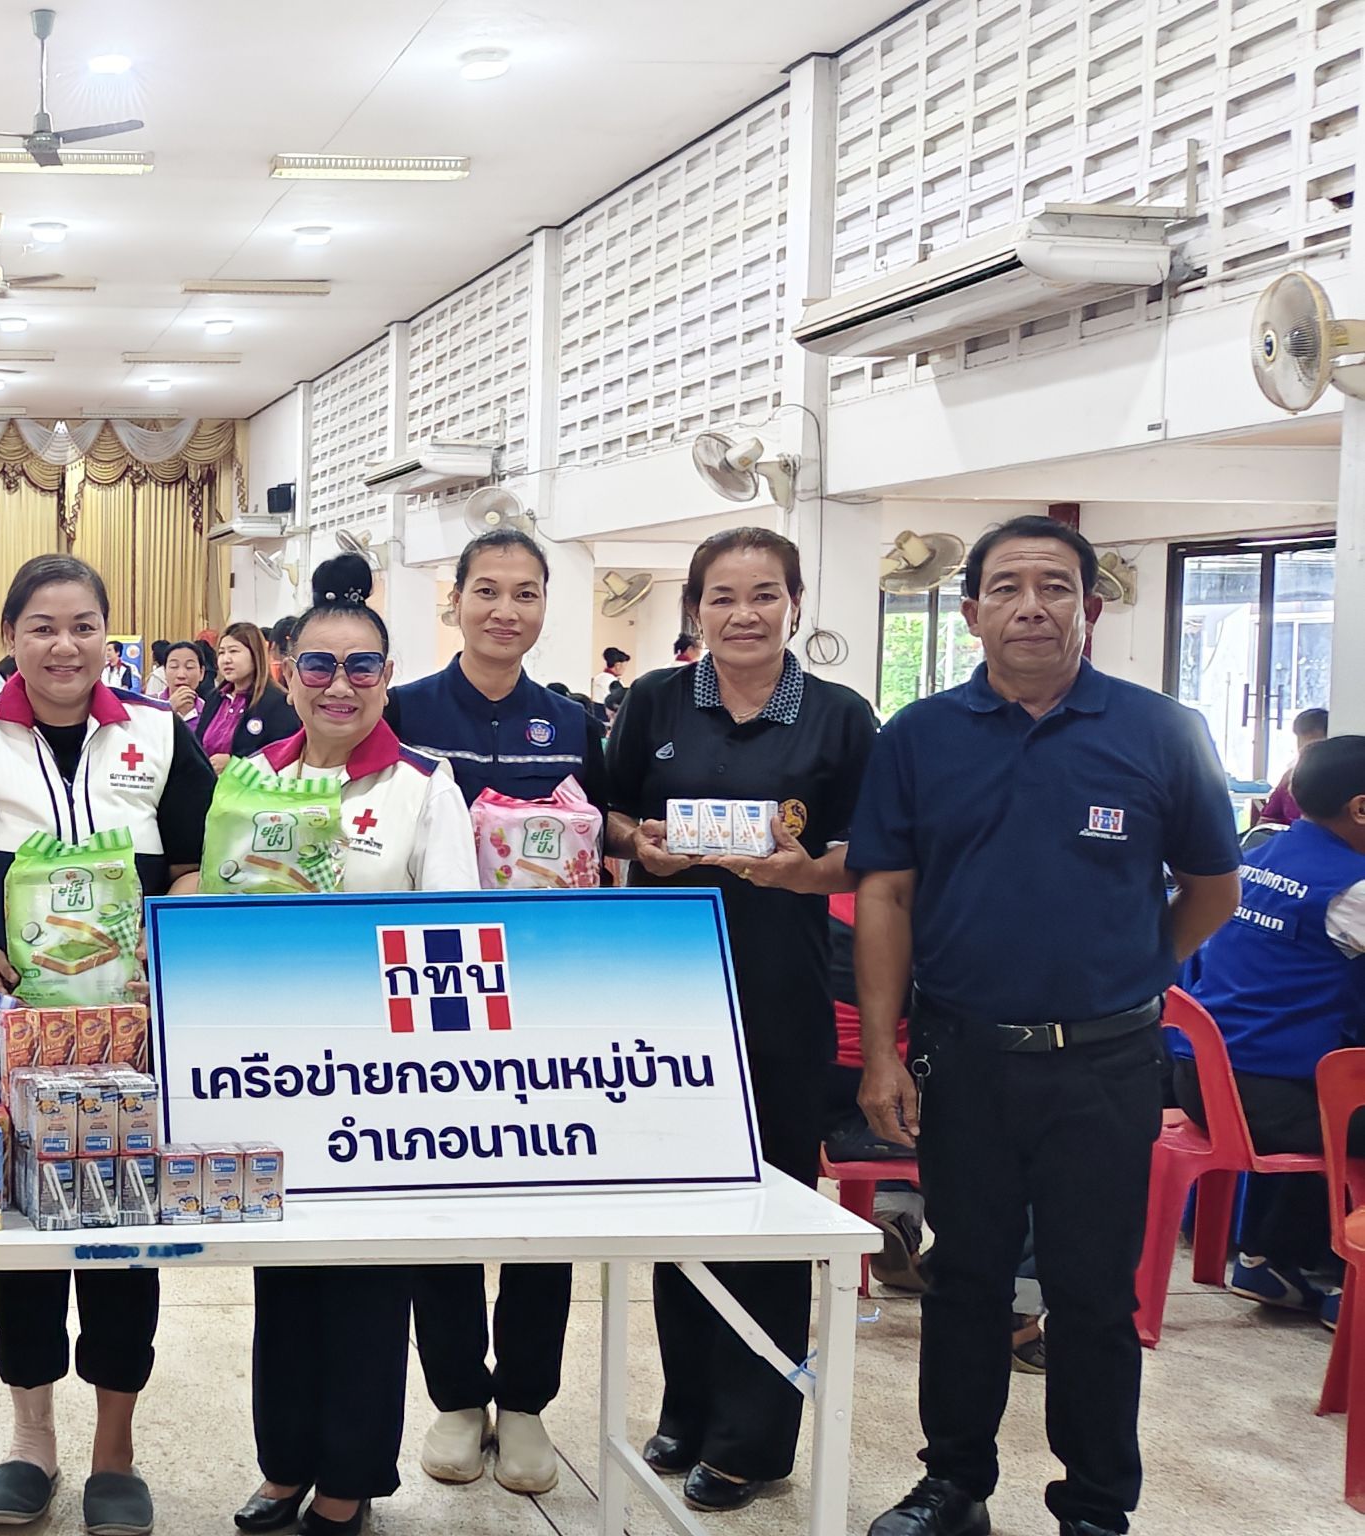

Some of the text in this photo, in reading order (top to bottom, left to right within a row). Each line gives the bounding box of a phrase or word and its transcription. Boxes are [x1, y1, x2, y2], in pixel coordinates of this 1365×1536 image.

[385, 963, 506, 996] กทบ
[191, 1040, 715, 1105] เครือข่ายกองทุนหมู่บ้าน
[327, 1119, 597, 1163] อำเภอนาแก
